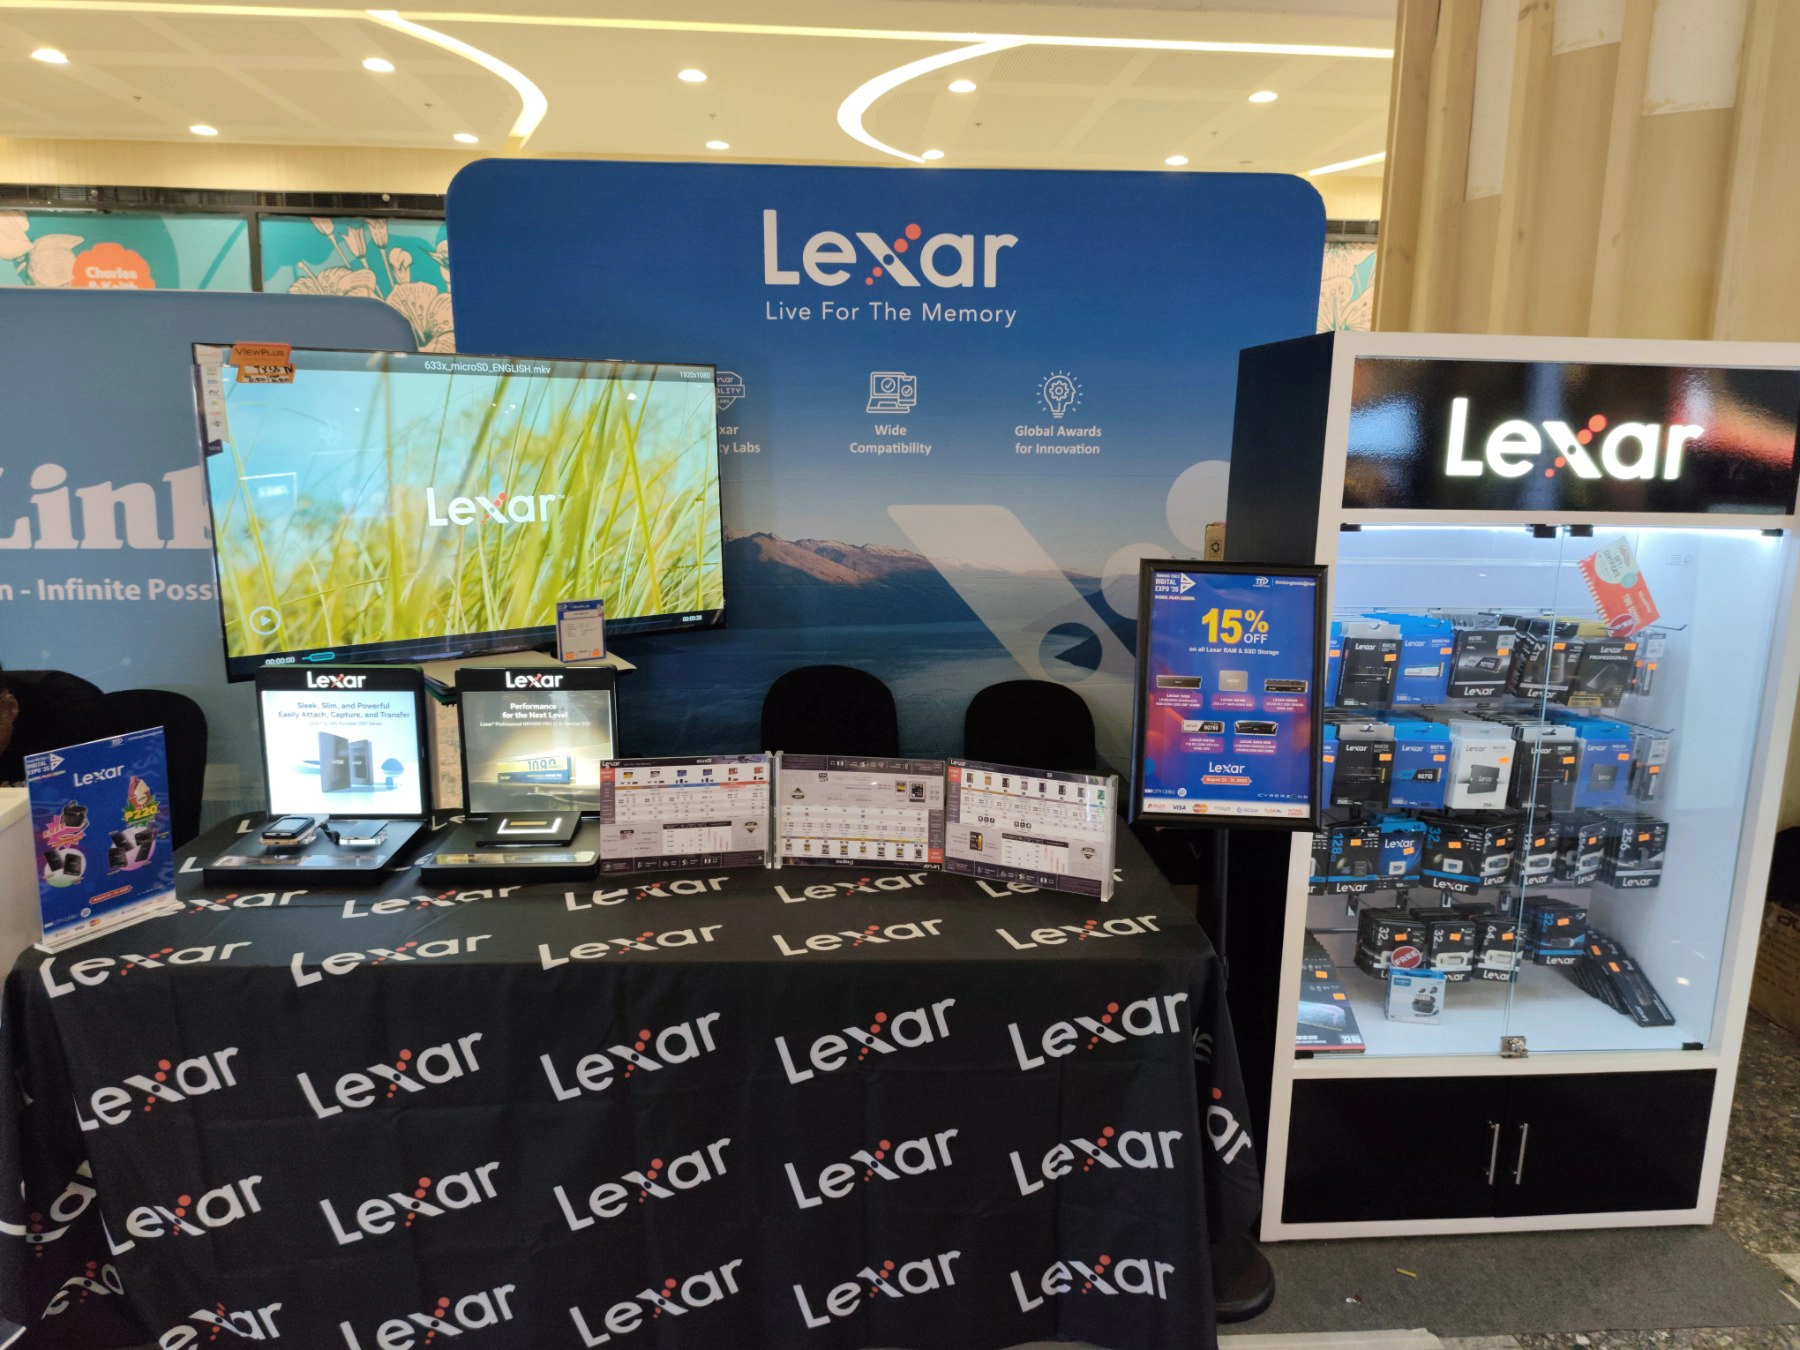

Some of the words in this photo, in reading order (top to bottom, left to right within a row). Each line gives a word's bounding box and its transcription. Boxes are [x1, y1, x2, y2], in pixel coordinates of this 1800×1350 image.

[763, 209, 1019, 288] Lexar
[85, 266, 138, 280] Charles
[766, 301, 811, 321] Live
[822, 302, 859, 321] For
[869, 302, 911, 321] The
[922, 303, 1016, 328] Memory
[719, 426, 739, 435] xar
[874, 424, 907, 437] Wide
[1015, 425, 1054, 438] Global
[1056, 425, 1102, 438] Awards
[1445, 397, 1704, 480] Lexar
[733, 442, 761, 453] Labs
[850, 442, 932, 456] Compatibility
[1015, 443, 1033, 455] for
[1035, 443, 1100, 455] Innovation
[426, 487, 556, 527] Lexar
[38, 578, 140, 601] Infinite
[1201, 608, 1269, 644] 15%
[1243, 633, 1268, 645] OFF
[306, 671, 367, 688] Lexar
[505, 671, 563, 688] Lexar
[1464, 686, 1495, 696] Lexar
[278, 711, 299, 719] Easily
[331, 711, 363, 719] Capture,
[502, 711, 513, 719] for
[529, 711, 547, 719] Next
[548, 711, 568, 719] Level
[1346, 744, 1369, 752] Lexar
[74, 765, 124, 787] Lexar
[1209, 761, 1245, 774] Lexar
[1384, 838, 1415, 849] Lexar
[775, 873, 928, 904] Lexar
[1336, 882, 1368, 893] Lexar
[1433, 878, 1470, 892] Lexar
[1484, 875, 1506, 886] Lexar
[1578, 873, 1596, 884] Lexar
[1622, 877, 1652, 887] Lexar
[183, 890, 309, 915] xar
[342, 886, 522, 919] Lexar
[564, 877, 729, 911] Lexar
[772, 919, 943, 956] Lexar
[996, 915, 1157, 950] Lexar
[538, 924, 723, 970] Lexar
[1394, 949, 1419, 965] FREE
[1546, 956, 1576, 965] Lexar
[39, 942, 253, 998] Lexar
[291, 934, 493, 988] Lexar
[1483, 970, 1511, 981] Lexar
[775, 999, 956, 1084] Lexar
[1008, 992, 1188, 1071] Lexar
[539, 1012, 721, 1101] Lexar
[73, 1047, 239, 1131] Lexar
[297, 1032, 483, 1119] Lexar
[784, 1128, 959, 1209] Lexar
[1009, 1126, 1183, 1196] Lexar
[553, 1137, 731, 1232] Lexar
[100, 1174, 263, 1255] Lexar
[320, 1161, 500, 1246] Lexar
[793, 1250, 961, 1329] Lexar
[1009, 1255, 1176, 1313] Lexar
[569, 1258, 743, 1348] Lexar
[159, 1302, 283, 1350] exar
[340, 1284, 516, 1350] Lexar
